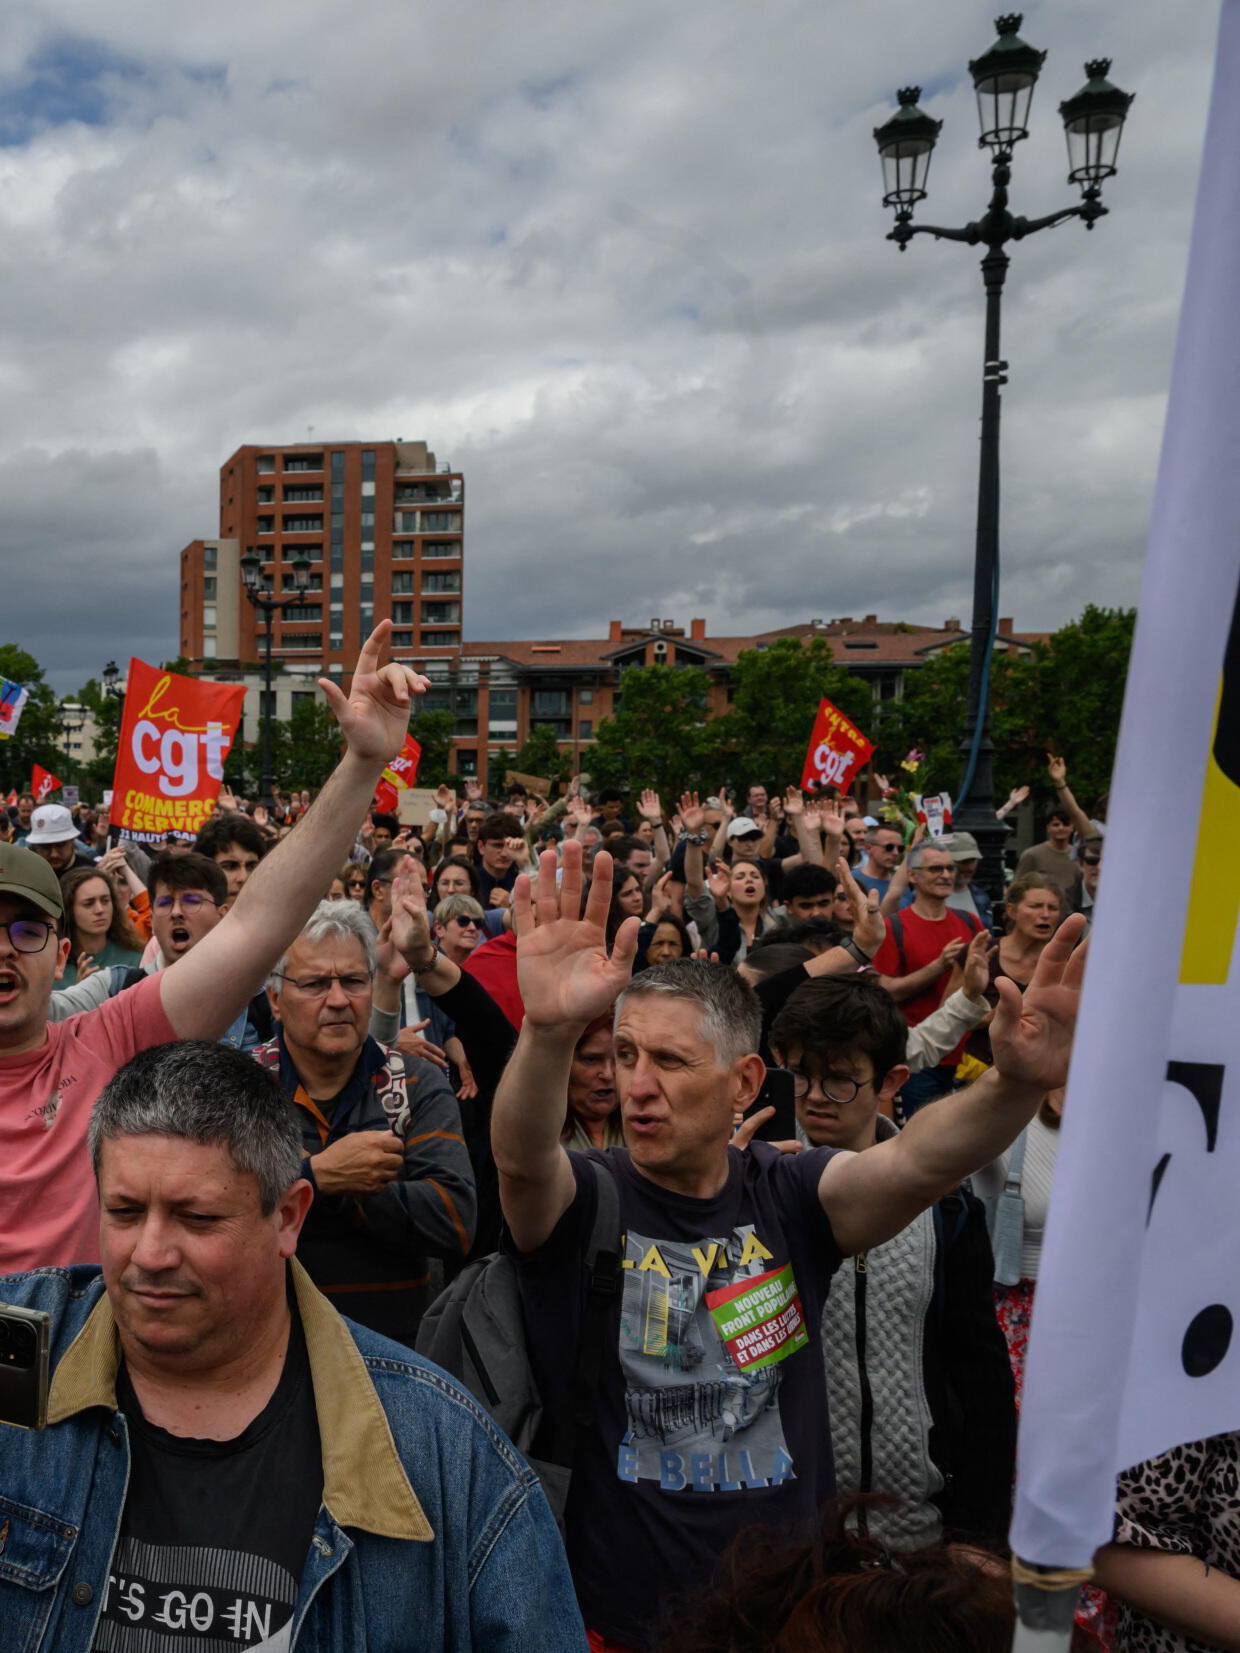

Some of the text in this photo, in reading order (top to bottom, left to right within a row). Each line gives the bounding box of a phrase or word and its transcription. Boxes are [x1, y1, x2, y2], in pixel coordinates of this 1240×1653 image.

[131, 719, 231, 797] cgt
[813, 743, 855, 785] cgt
[734, 1279, 784, 1314] NOUVEAU
[720, 1309, 758, 1337] FRONT
[735, 1328, 764, 1350] DANS
[761, 1316, 781, 1337] LES
[736, 1350, 750, 1364] ET
[748, 1335, 777, 1358] DANS
[774, 1326, 788, 1345] LES
[659, 1446, 800, 1493] BELLA
[151, 1589, 215, 1633] GO
[219, 1597, 273, 1641] IN
